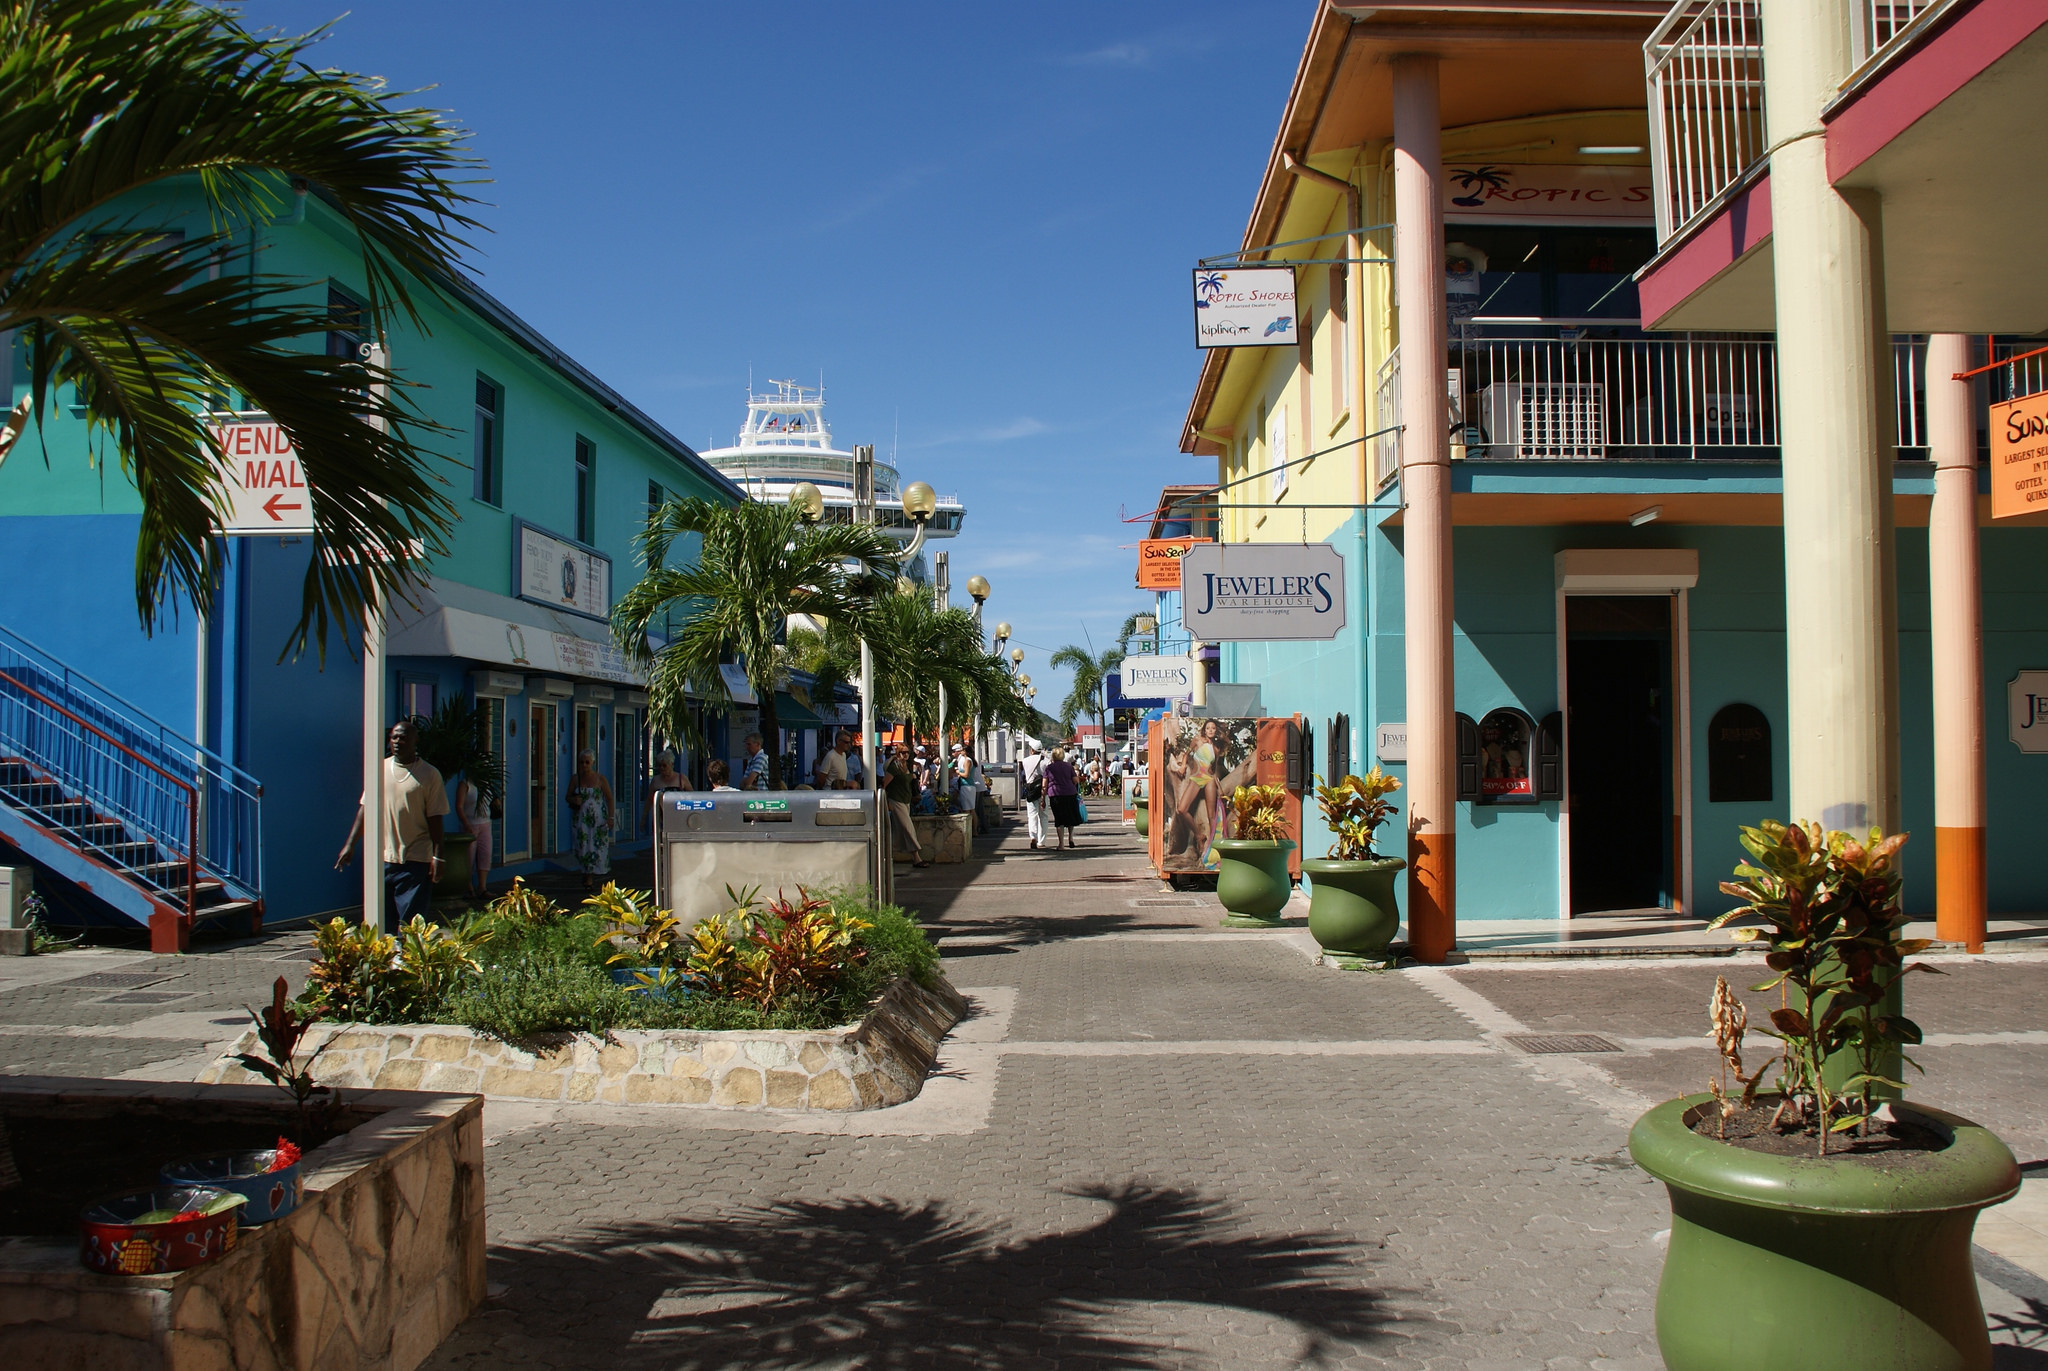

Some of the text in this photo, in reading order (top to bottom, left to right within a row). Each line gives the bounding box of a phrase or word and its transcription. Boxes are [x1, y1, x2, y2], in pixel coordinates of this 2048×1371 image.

[1249, 290, 1295, 301] SHORES
[1201, 324, 1237, 337] kipling
[217, 427, 293, 455] VEND
[2004, 449, 2035, 465] LARGEST
[245, 460, 305, 489] MAL
[2033, 463, 2041, 472] IN
[2015, 477, 2043, 491] GOTTEX
[1197, 572, 1332, 614] JEWELER'S
[1217, 597, 1313, 606] WAREHOUSE
[1128, 667, 1187, 686] JEWELER'S
[1482, 781, 1527, 790] 50% OFF
